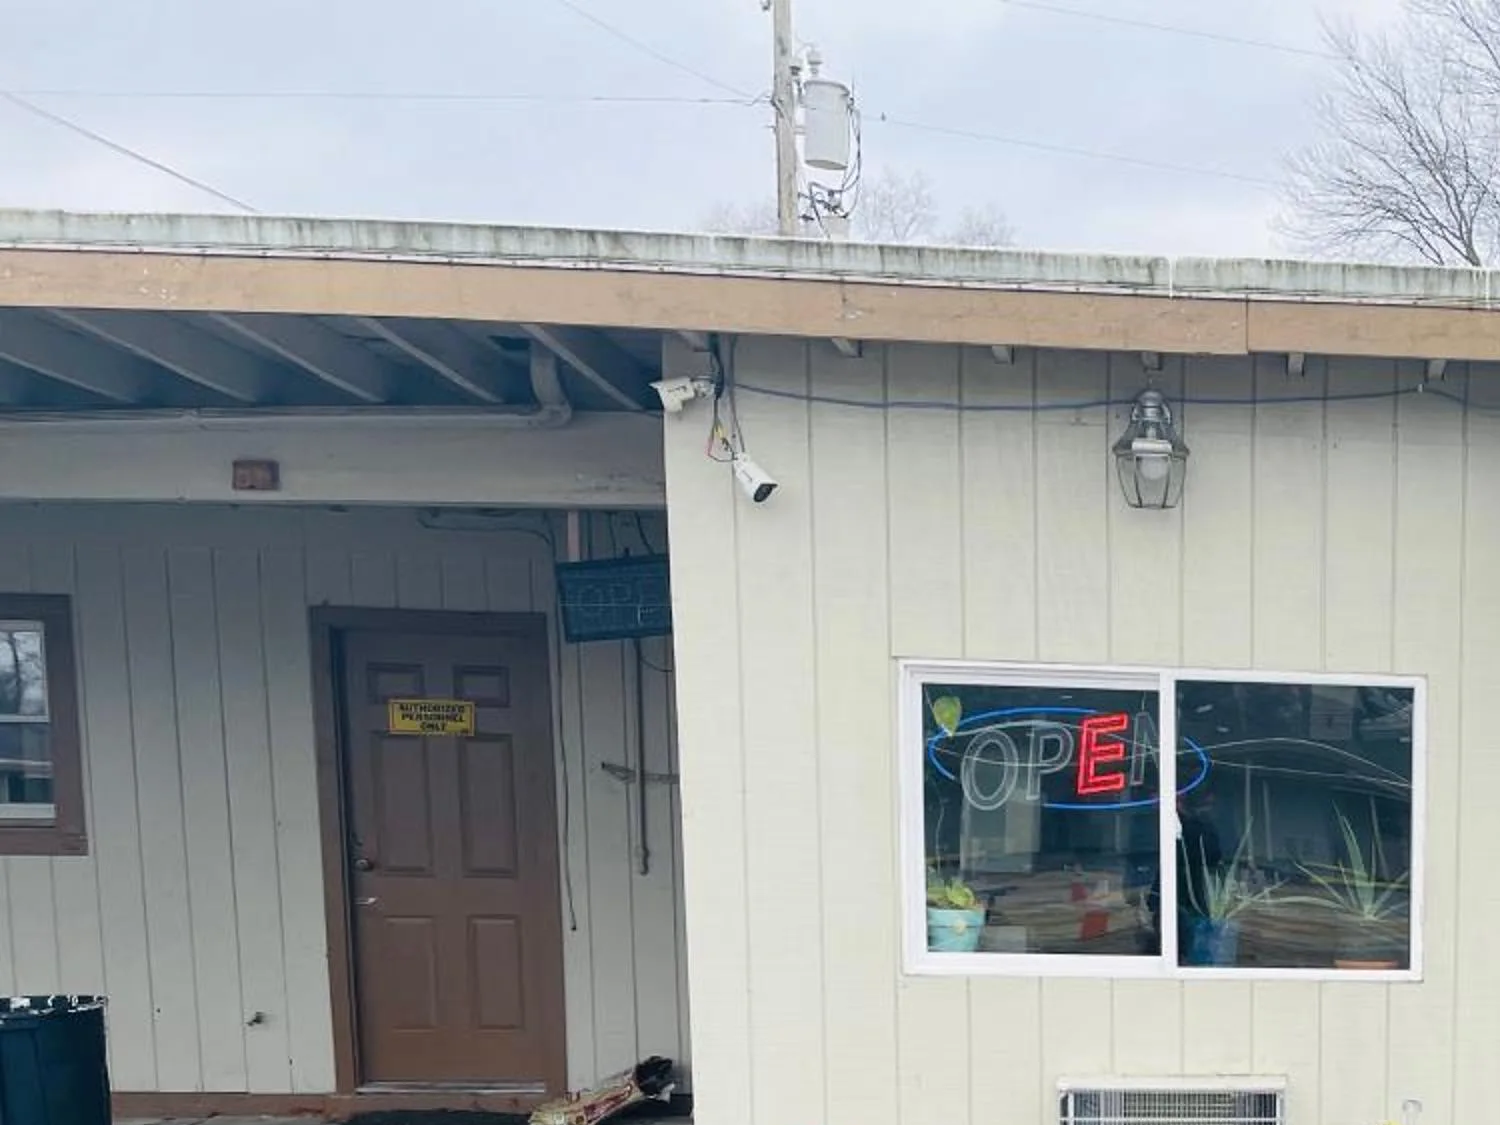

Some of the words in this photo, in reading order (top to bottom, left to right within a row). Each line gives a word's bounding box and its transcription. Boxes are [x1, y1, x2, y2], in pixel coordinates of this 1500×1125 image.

[399, 703, 465, 713] AUTHORIZED
[401, 713, 464, 722] PERSONNEL
[419, 721, 446, 731] ONLY
